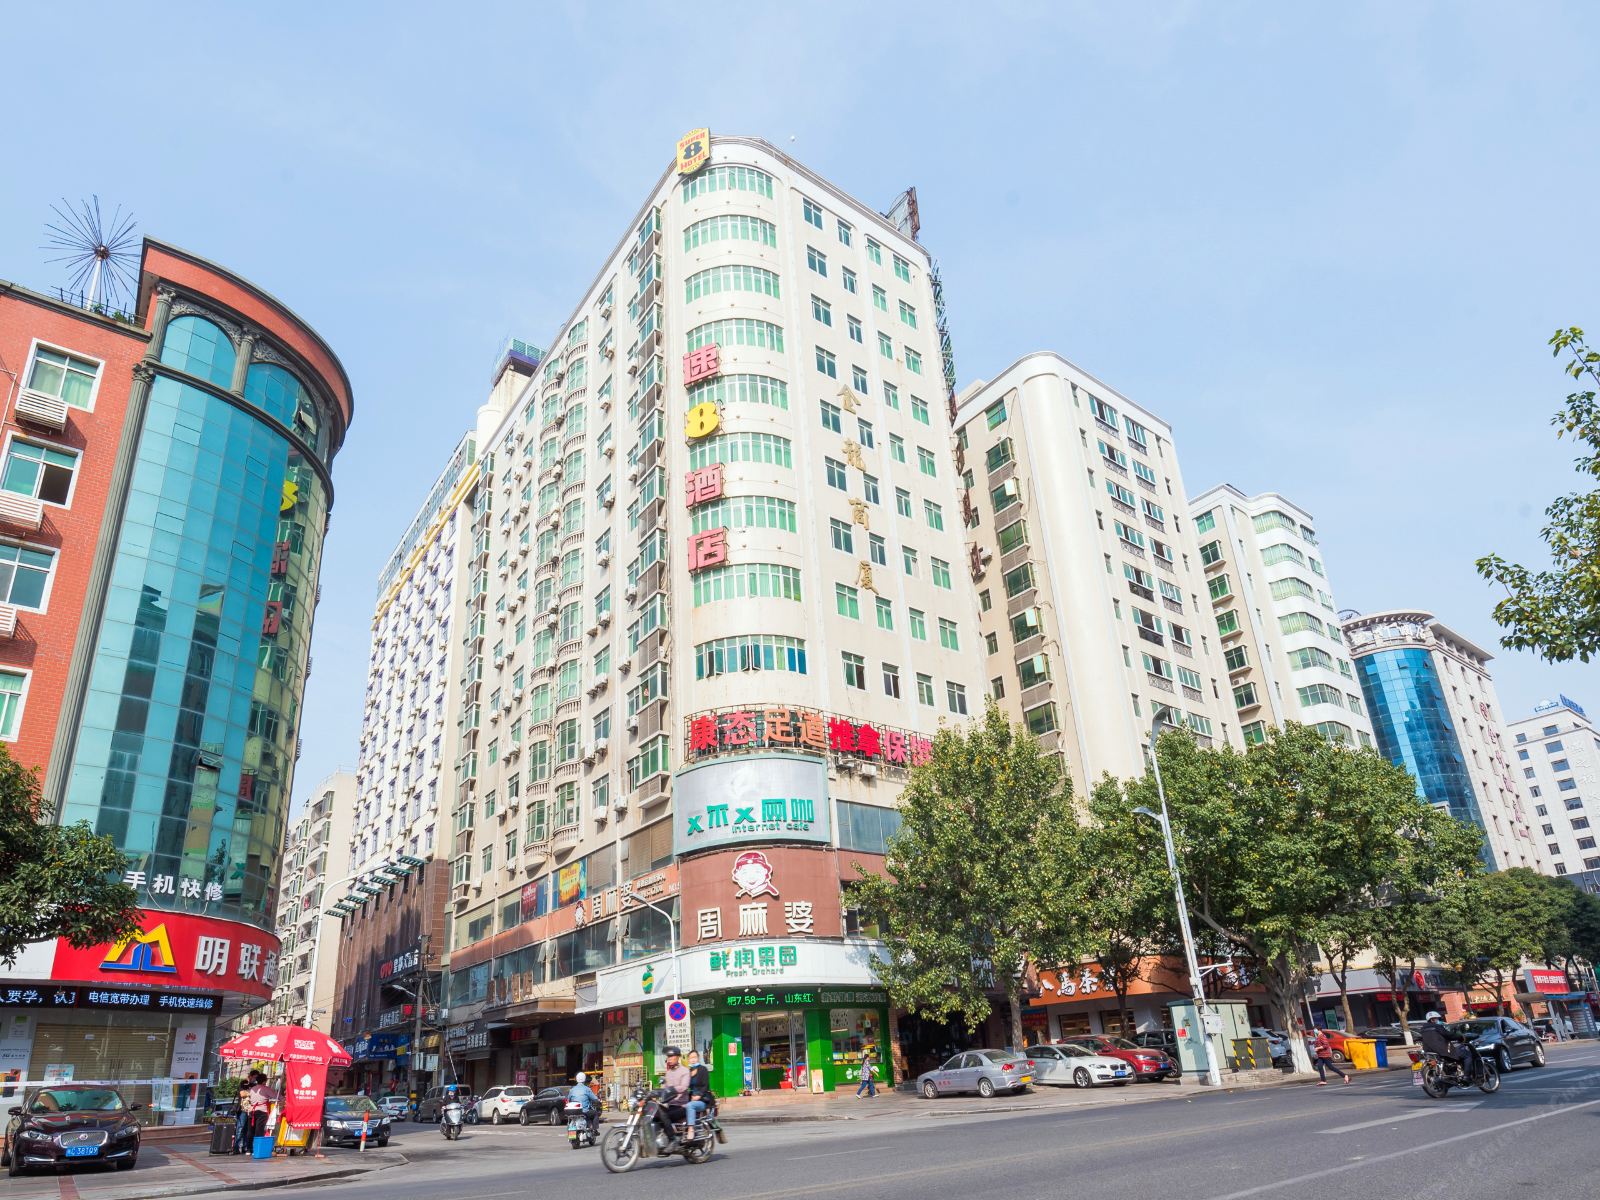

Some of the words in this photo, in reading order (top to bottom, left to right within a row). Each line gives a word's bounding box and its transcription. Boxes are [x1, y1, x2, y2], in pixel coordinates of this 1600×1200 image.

[680, 151, 705, 170] HOTEL
[683, 141, 702, 160] 8
[122, 871, 223, 901] 手机快修
[697, 902, 814, 941] 周麻婆
[709, 945, 798, 972] 鲜润果园
[726, 969, 748, 978] Fresh
[752, 967, 785, 976] Orchard
[88, 990, 150, 1006] 电信宽带办理
[158, 996, 213, 1010] 手机快速维修
